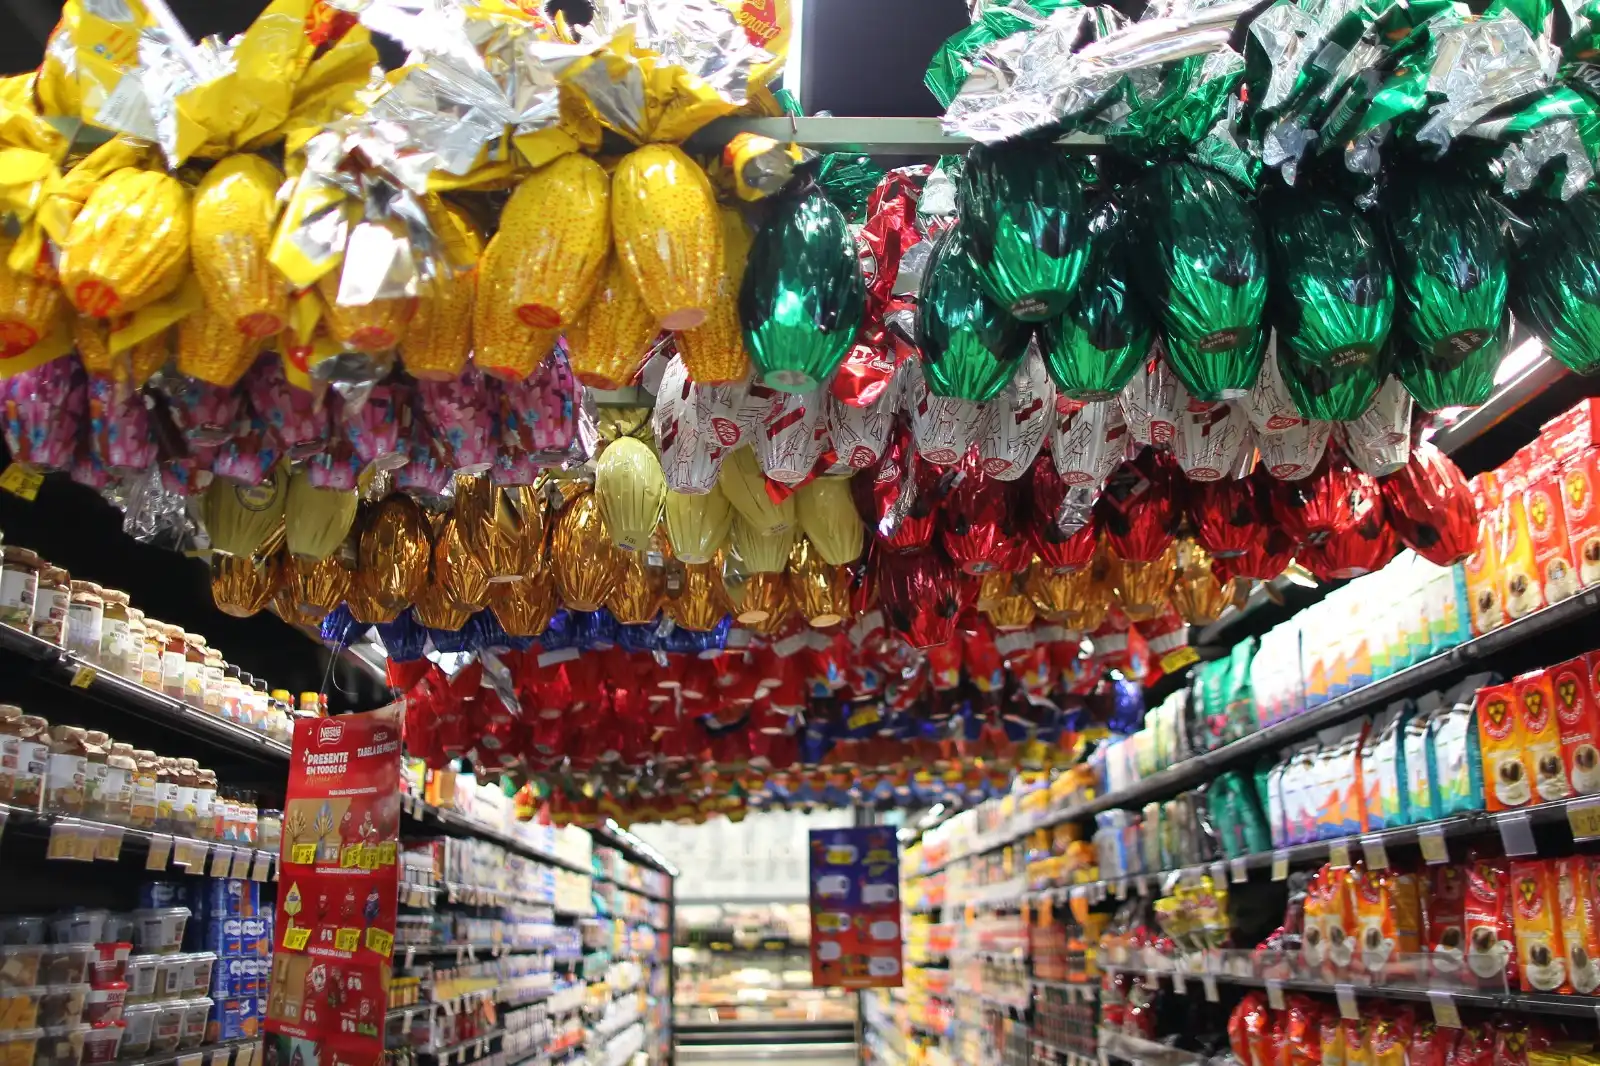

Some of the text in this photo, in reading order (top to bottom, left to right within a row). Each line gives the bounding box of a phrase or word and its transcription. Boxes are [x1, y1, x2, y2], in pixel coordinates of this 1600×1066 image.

[738, 11, 781, 40] erenata
[320, 726, 342, 738] Nestlé
[307, 752, 349, 765] PRESENTE
[317, 764, 338, 775] TODOS
[338, 764, 347, 773] OS
